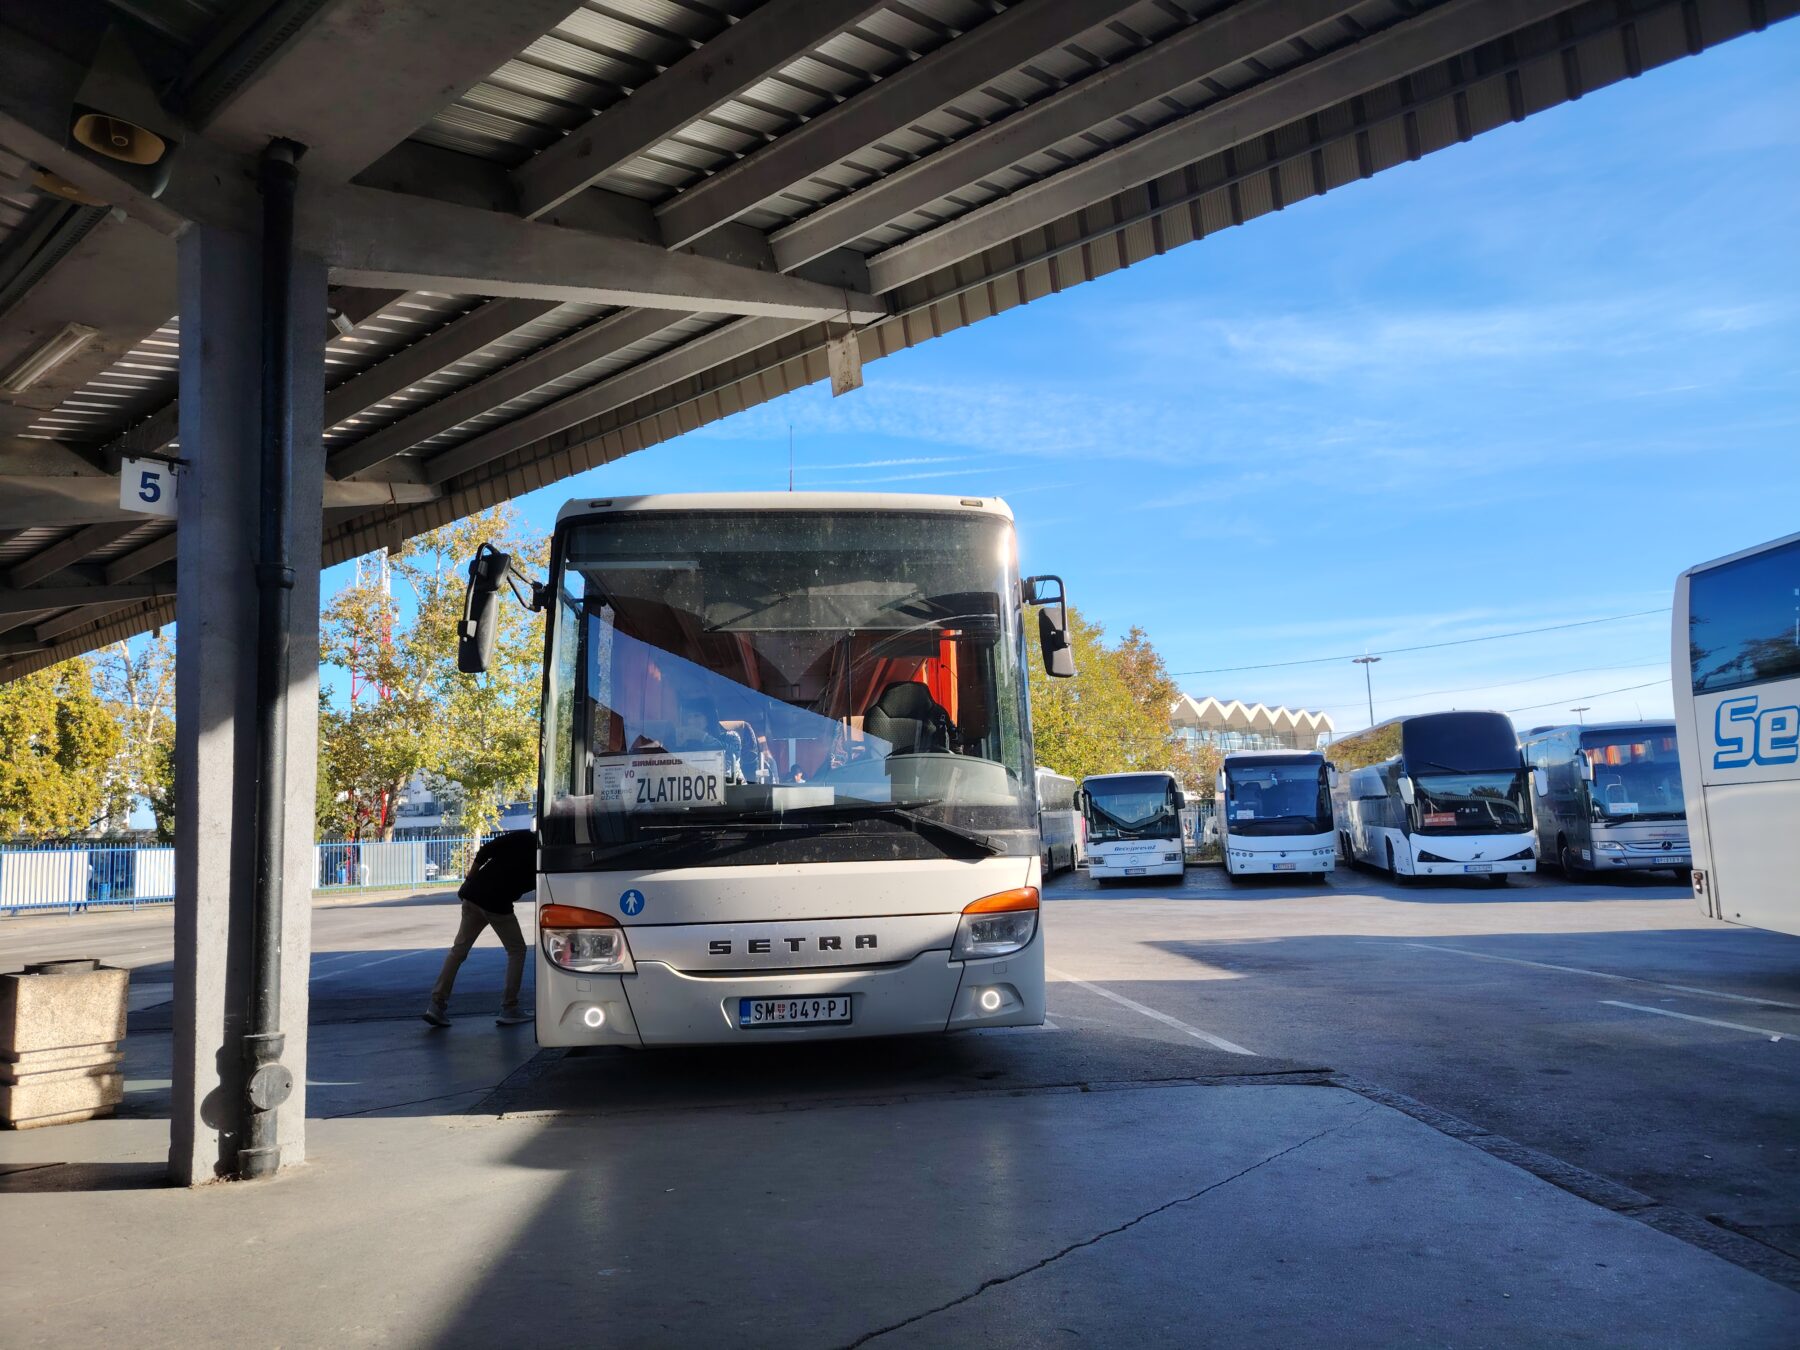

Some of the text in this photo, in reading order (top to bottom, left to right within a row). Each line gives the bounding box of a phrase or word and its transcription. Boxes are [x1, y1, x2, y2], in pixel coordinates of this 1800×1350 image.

[139, 471, 161, 503] 5
[636, 775, 718, 803] ZLATIBOR
[708, 934, 878, 955] SETRA
[754, 1002, 776, 1021] SM
